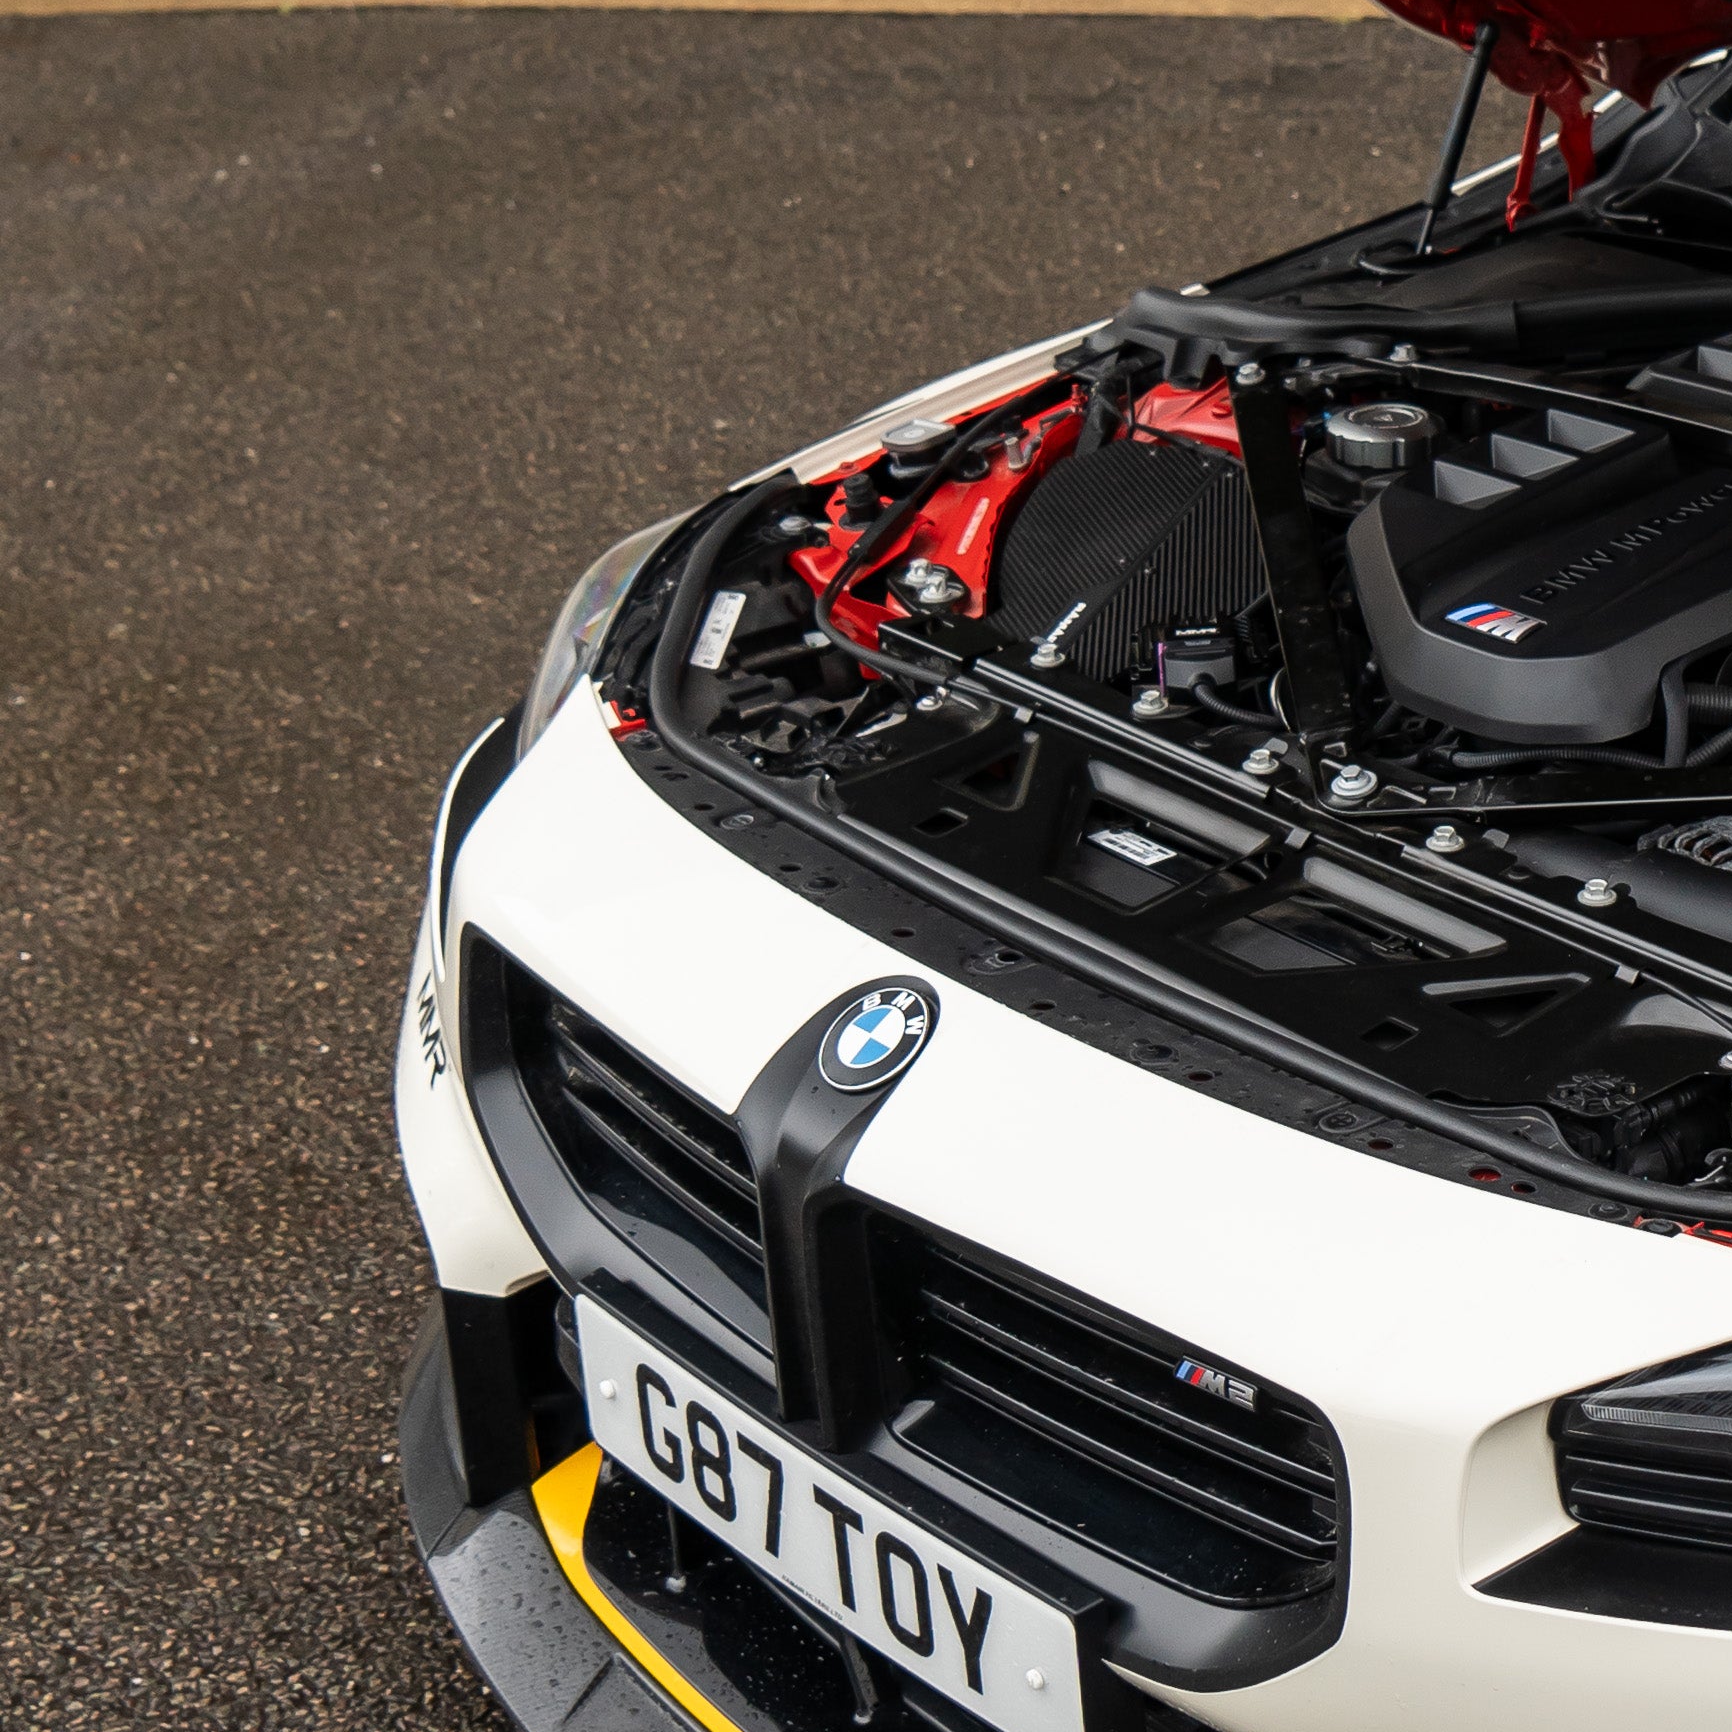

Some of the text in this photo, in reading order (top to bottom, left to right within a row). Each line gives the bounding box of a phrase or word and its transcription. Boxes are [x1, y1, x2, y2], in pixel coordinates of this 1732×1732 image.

[1519, 549, 1614, 605] BMW
[862, 991, 925, 1035] BMW
[1198, 1368, 1255, 1411] M2
[635, 1361, 994, 1695] G87 TOY
